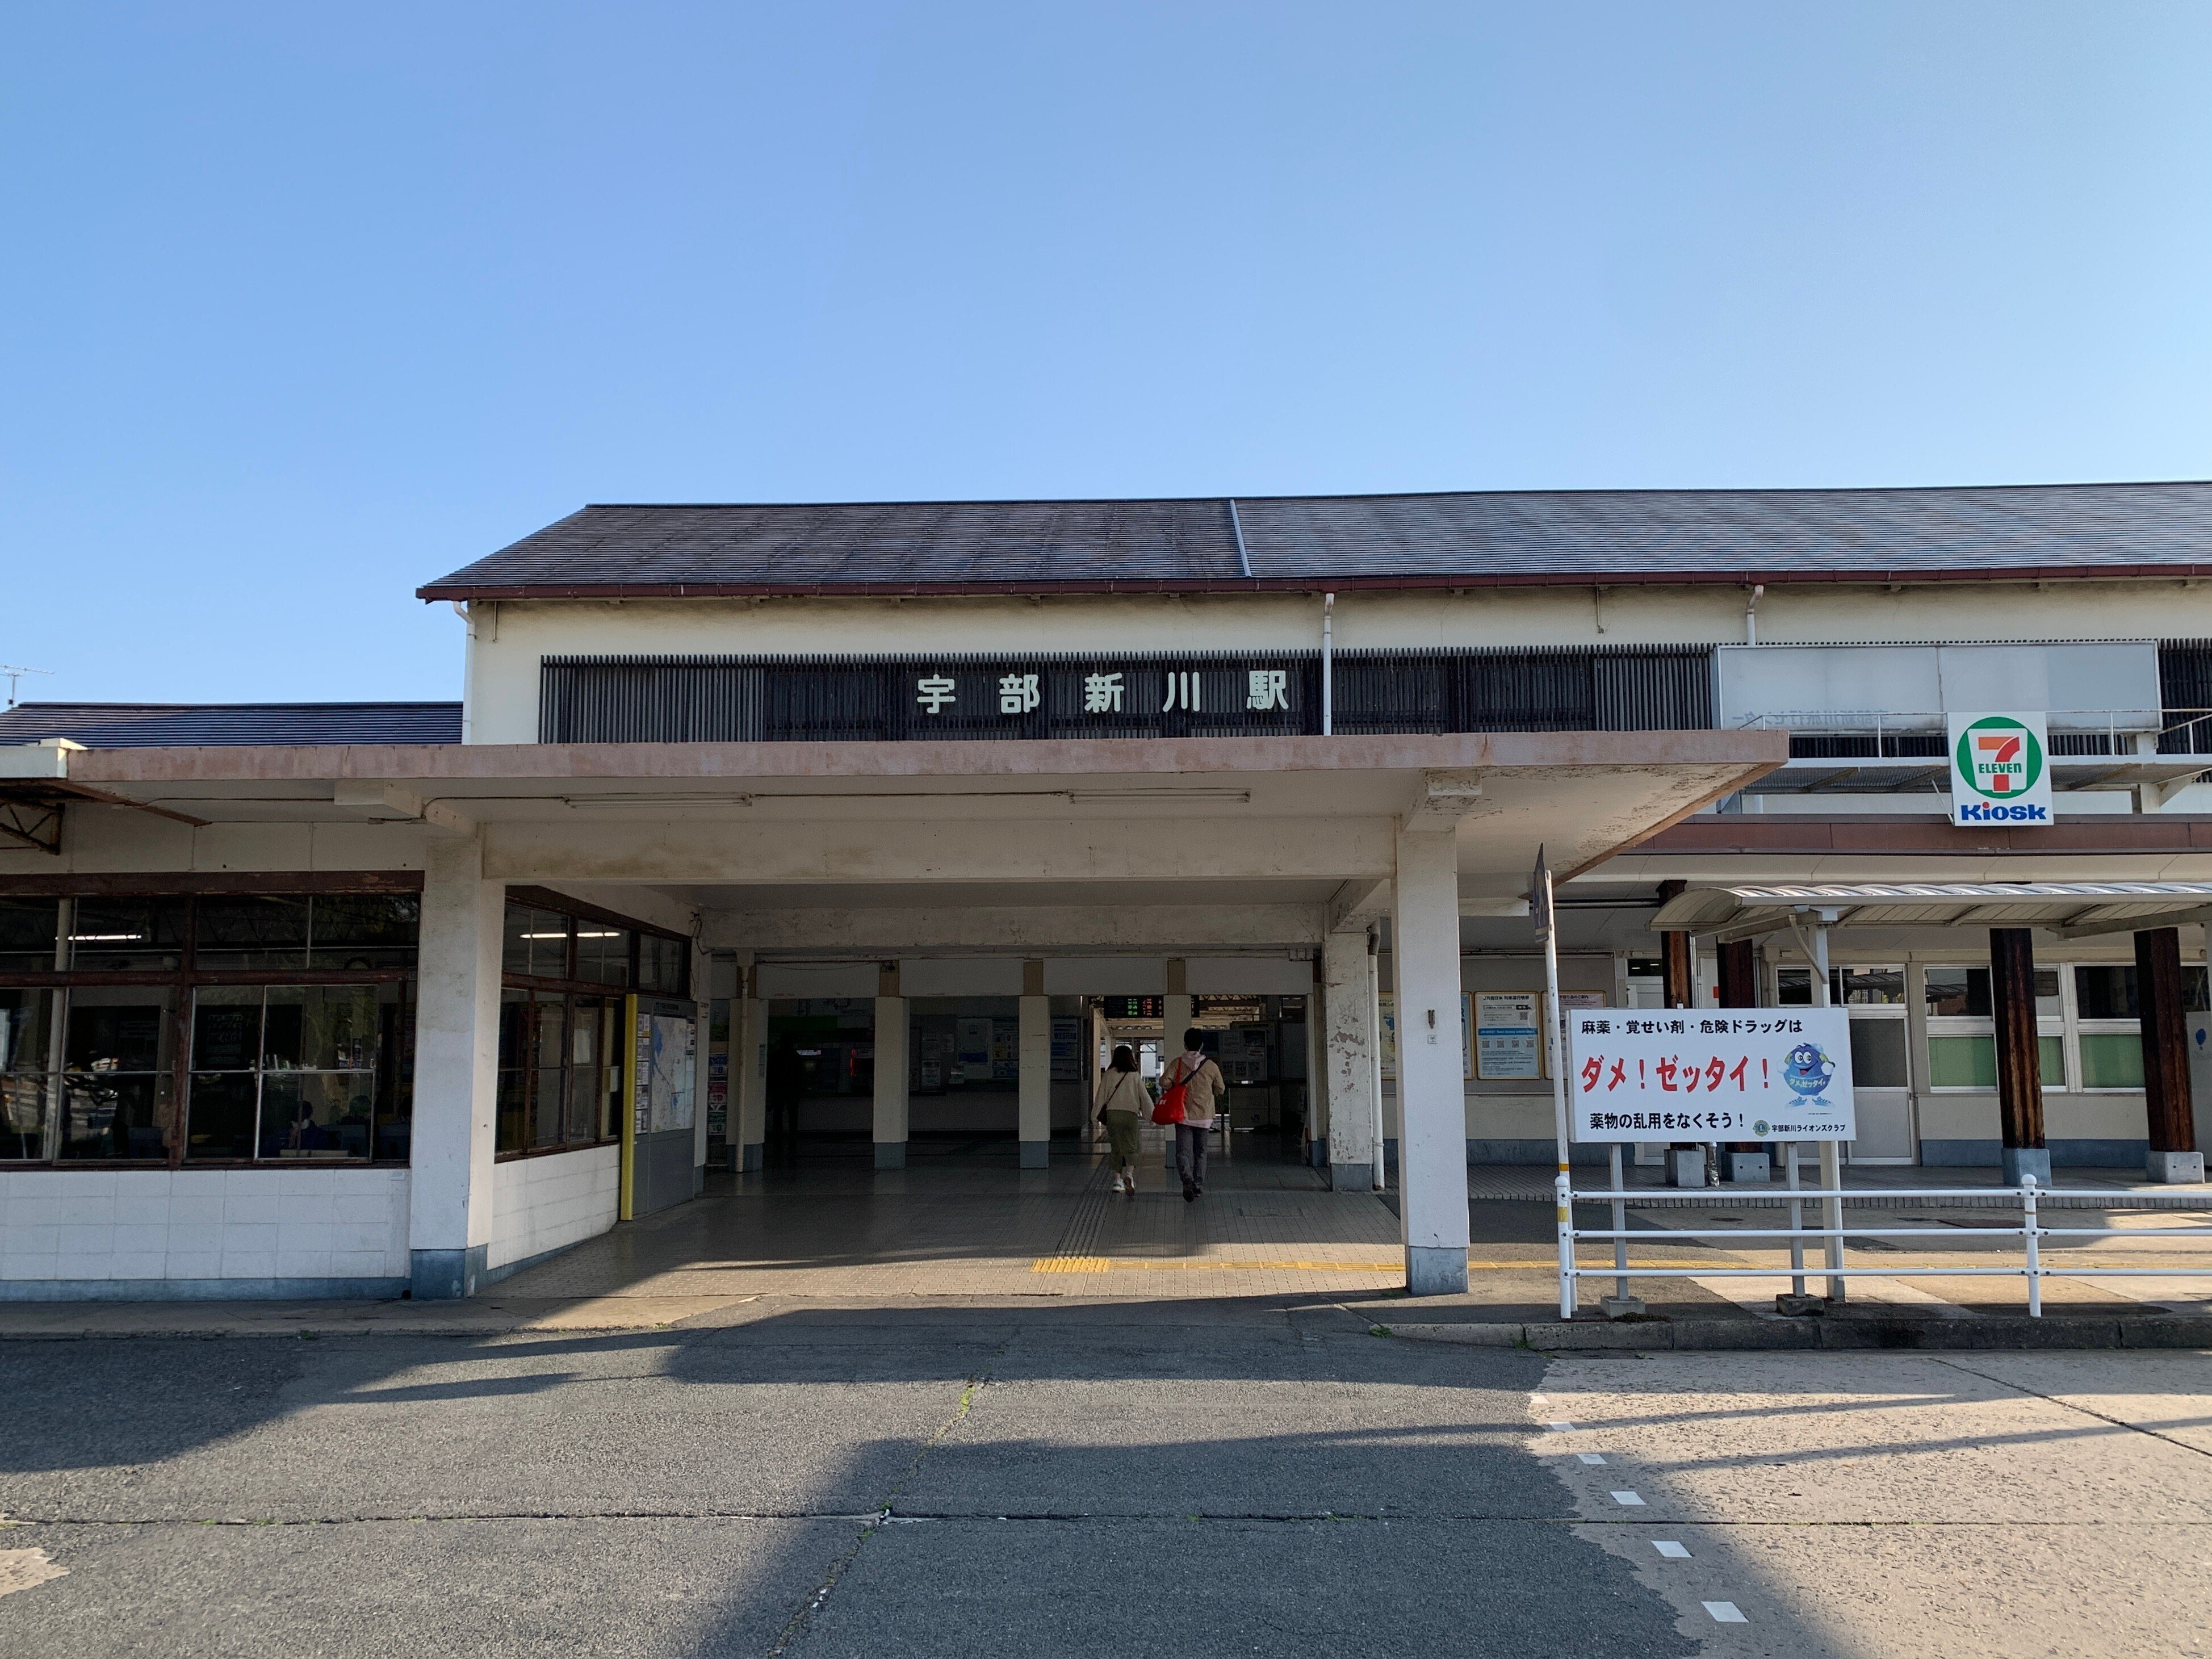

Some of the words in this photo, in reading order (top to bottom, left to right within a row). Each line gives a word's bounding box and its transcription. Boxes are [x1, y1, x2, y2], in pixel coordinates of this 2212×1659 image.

[916, 670, 1289, 714] 宇部新川駅
[1979, 737, 2020, 791] 7
[1960, 801, 2046, 820] Kiosk
[1581, 1019, 1803, 1034] 麻薬・覚せい剤・危険ドラッグは
[1581, 1055, 1769, 1092] ダメ！ゼッタイ！
[1590, 1112, 1745, 1130] 薬物の乱用をなくそう！
